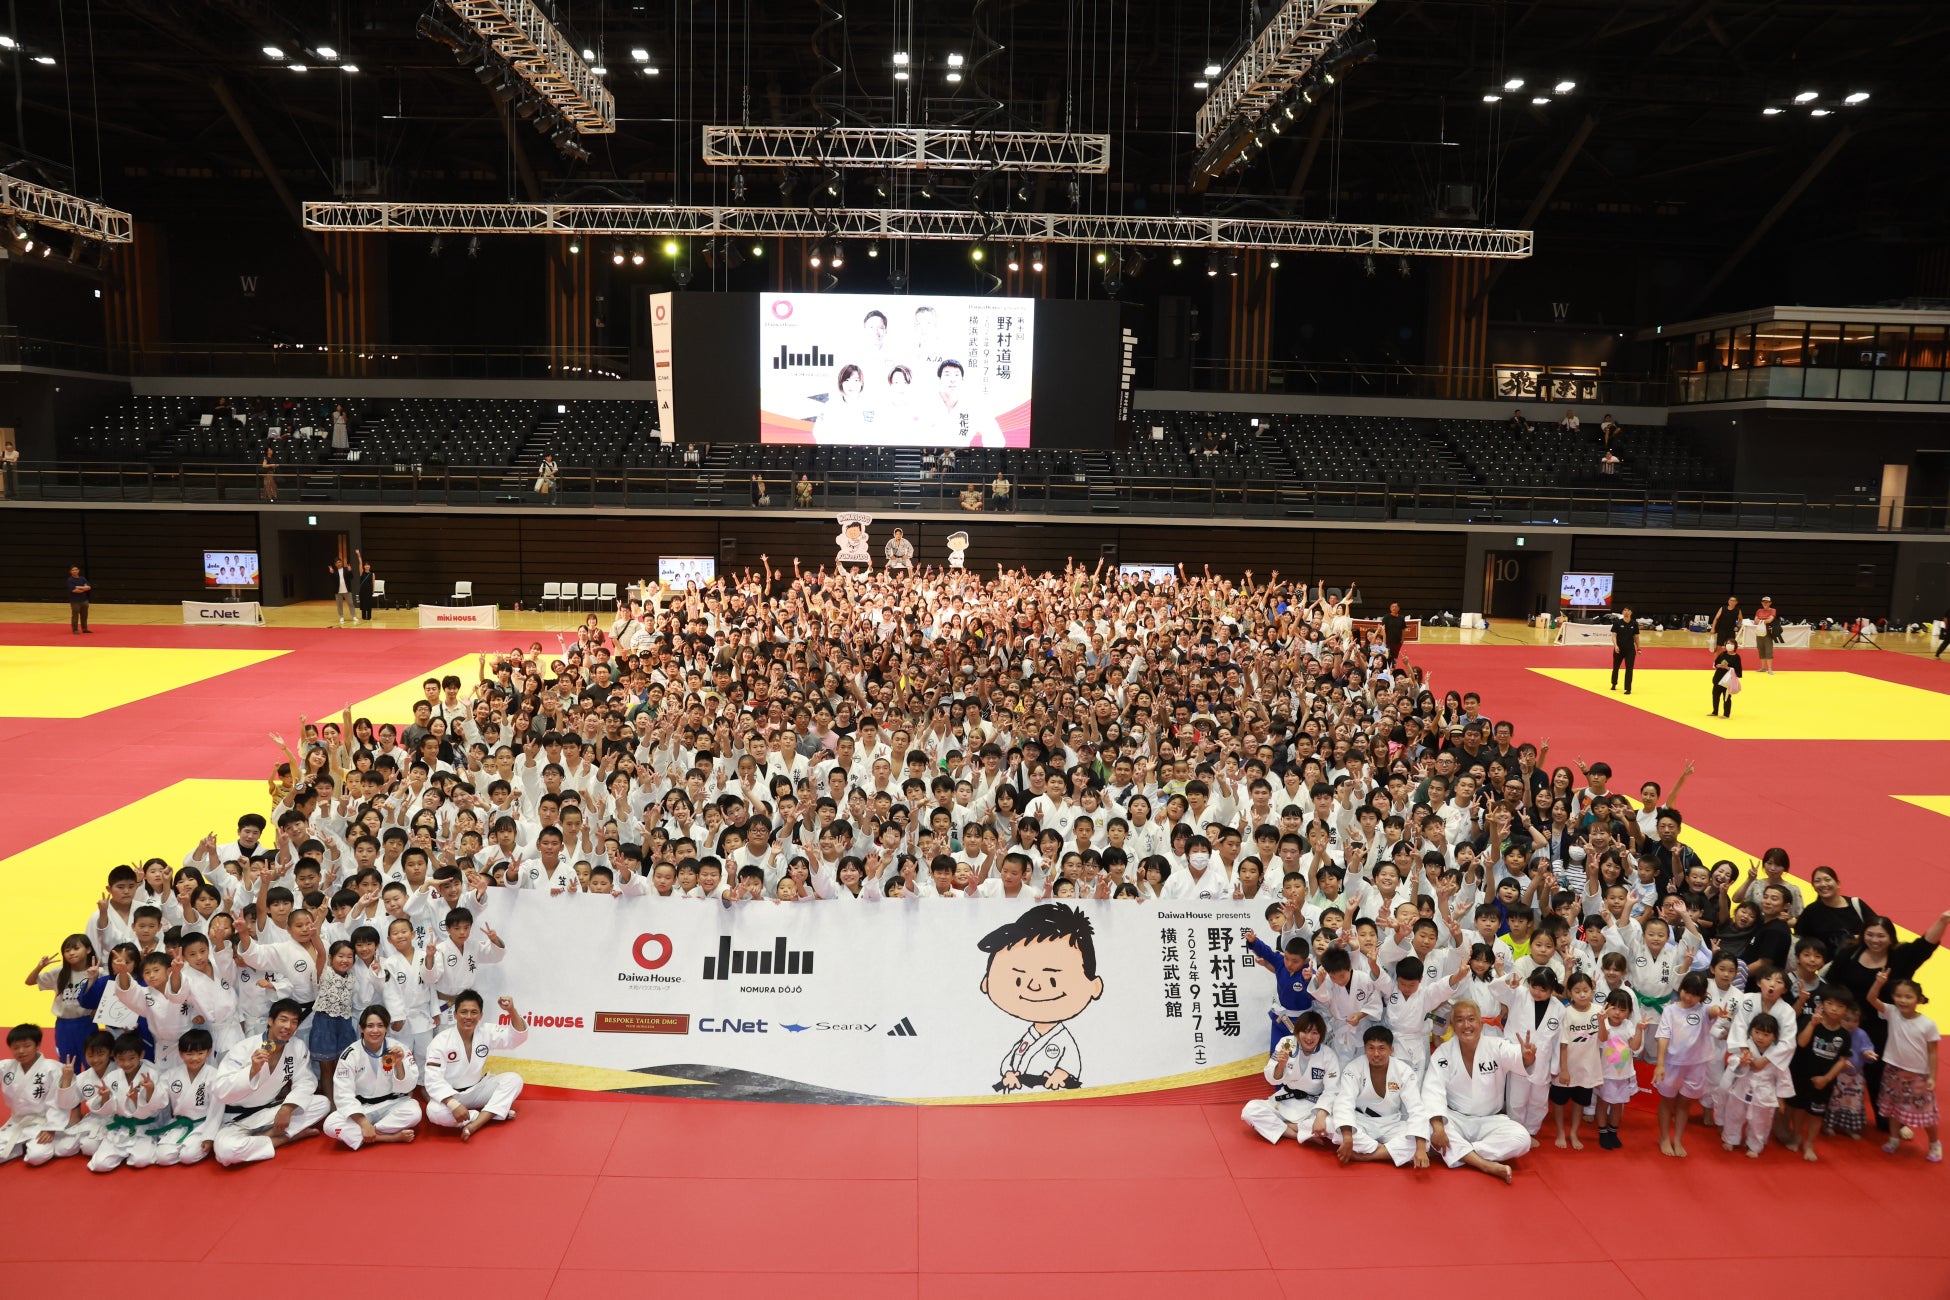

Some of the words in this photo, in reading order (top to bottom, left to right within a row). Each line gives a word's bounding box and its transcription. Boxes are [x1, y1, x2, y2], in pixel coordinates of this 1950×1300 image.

[1552, 302, 1569, 318] W
[996, 316, 1012, 379] 野村道場
[1496, 560, 1519, 581] 10
[200, 610, 240, 618] C.Net
[1216, 912, 1251, 920] presents
[1160, 928, 1183, 1018] 横浜武道館
[1207, 927, 1241, 1037] 野村道場
[698, 1018, 768, 1033] C.Net
[815, 1022, 878, 1032] Searay
[1569, 1024, 1600, 1032] Reebo
[1478, 1060, 1498, 1072] KJA
